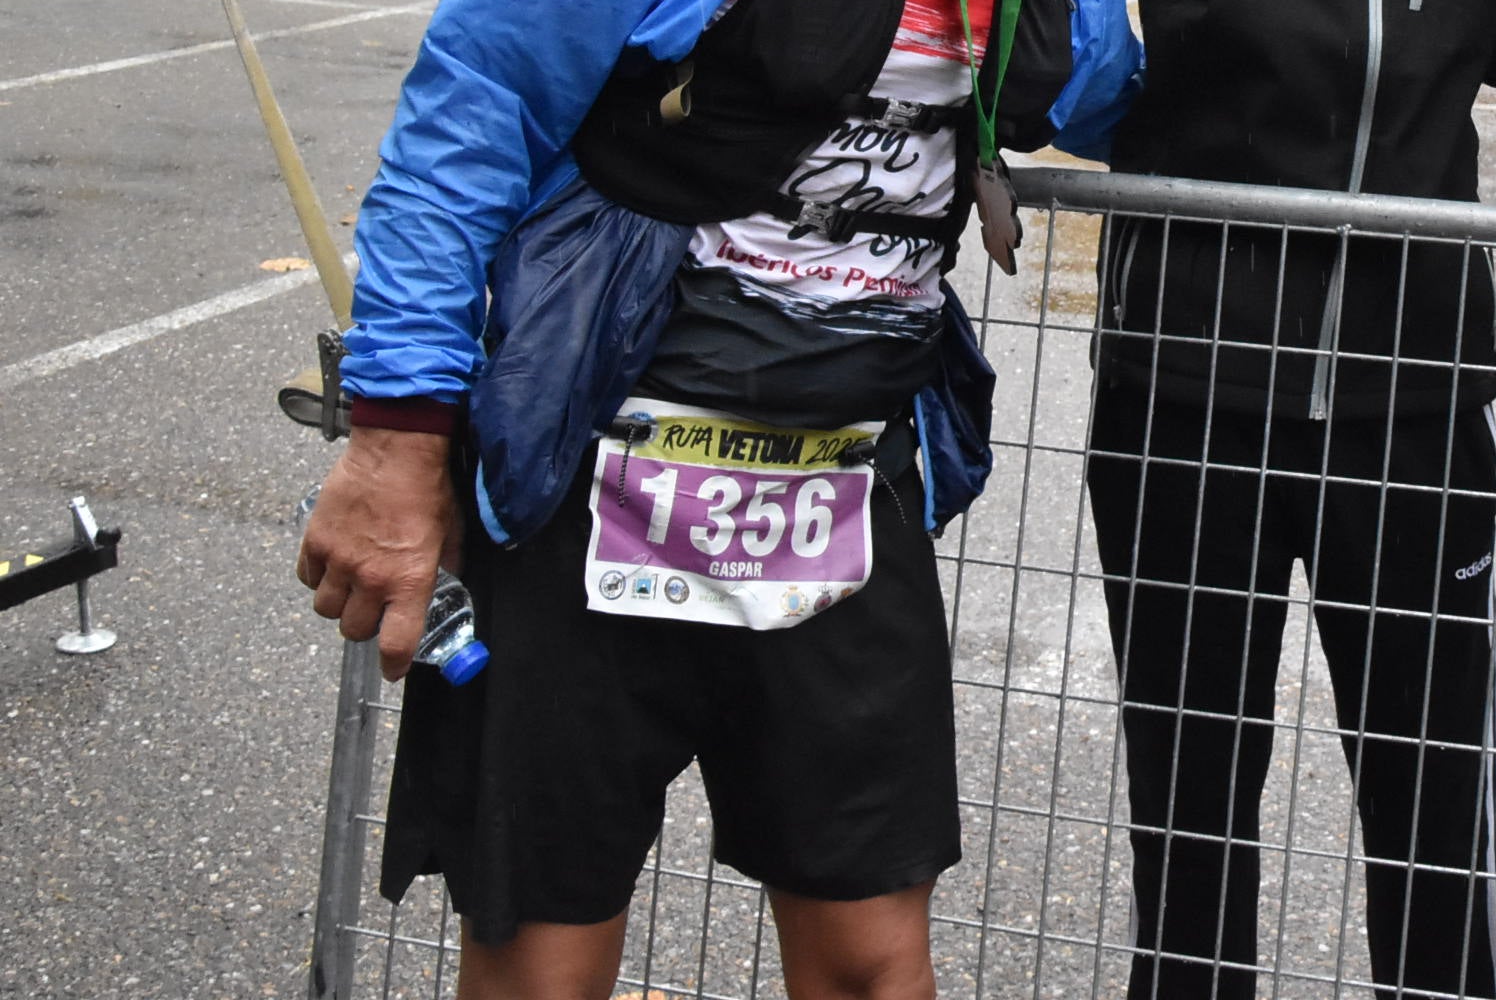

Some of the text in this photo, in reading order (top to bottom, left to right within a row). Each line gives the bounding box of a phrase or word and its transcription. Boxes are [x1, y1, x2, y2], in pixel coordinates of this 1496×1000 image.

[663, 424, 713, 457] RUTA
[717, 428, 805, 465] VETONA
[640, 468, 837, 559] 1356
[709, 561, 763, 579] GASPAR
[1455, 552, 1492, 580] adidas
